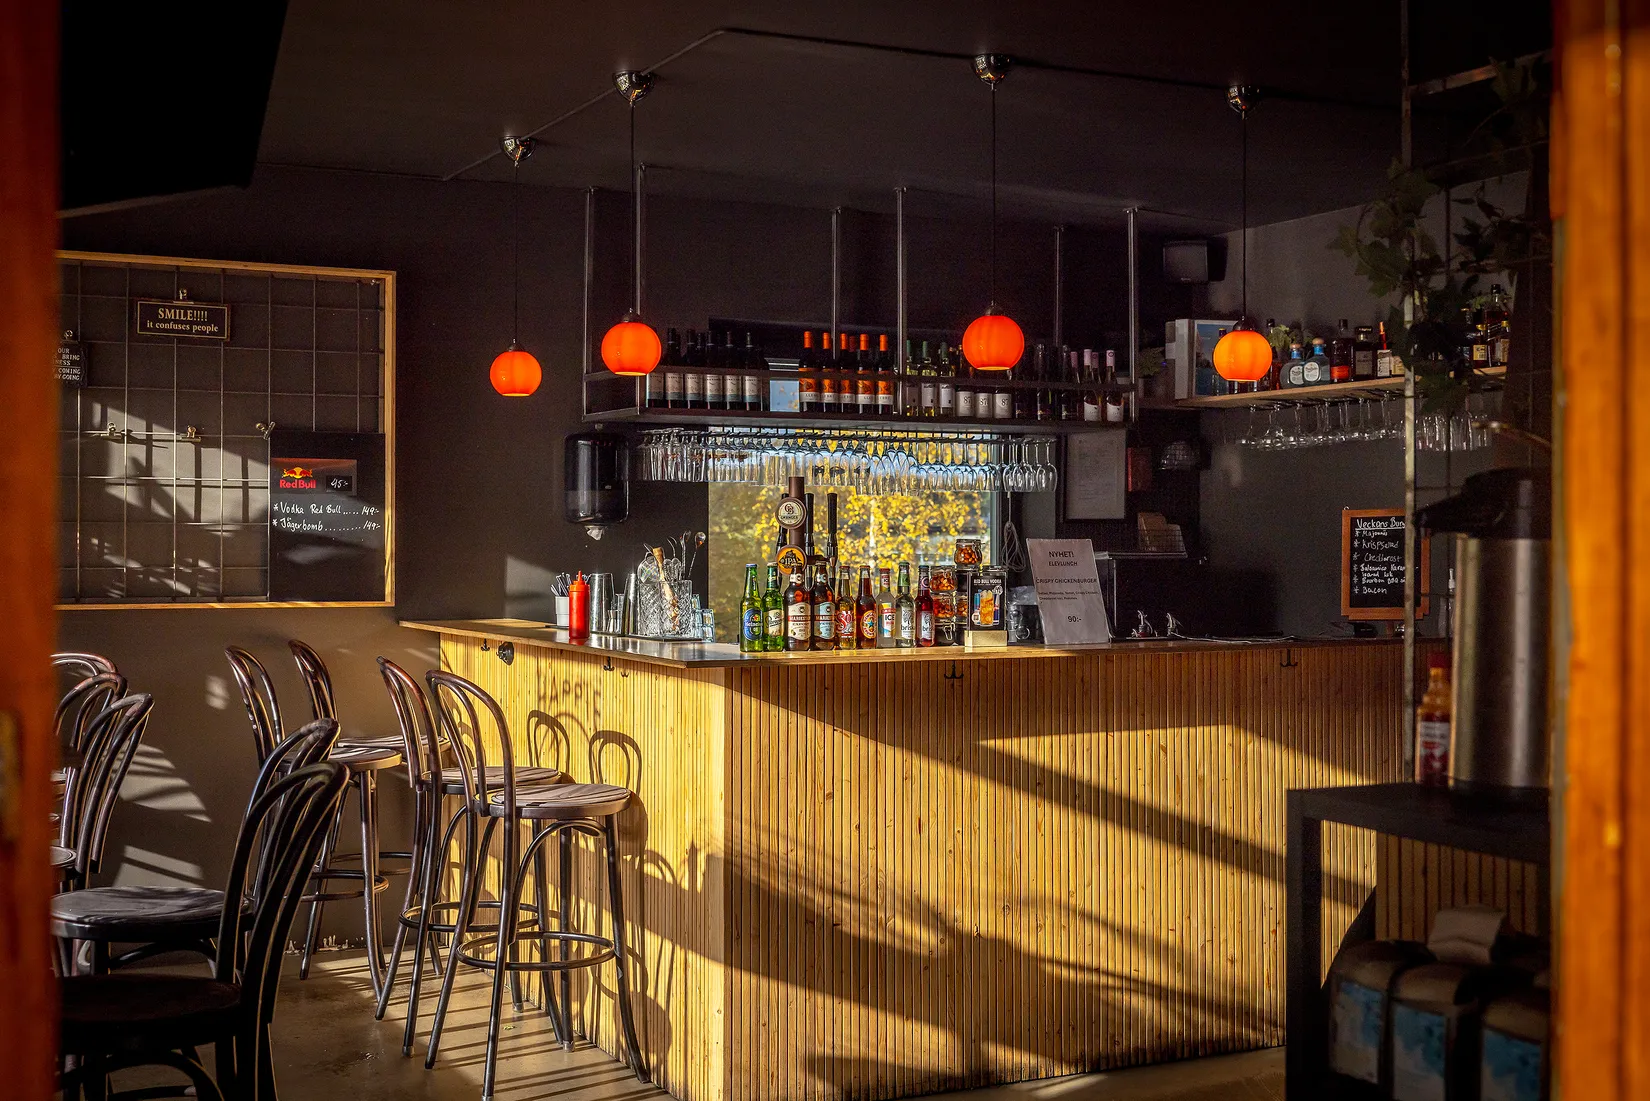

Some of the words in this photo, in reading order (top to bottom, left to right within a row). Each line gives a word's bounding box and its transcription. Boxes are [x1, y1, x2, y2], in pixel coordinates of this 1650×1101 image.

[158, 307, 208, 321] SMILE!!!!
[147, 320, 154, 328] it
[155, 321, 190, 330] confuses
[192, 324, 219, 334] people
[280, 480, 299, 489] Red
[299, 480, 317, 490] Bull
[280, 502, 305, 514] Vodka
[310, 503, 324, 515] Red
[280, 517, 324, 533] Jägerbomb
[1356, 518, 1389, 529] Veckans
[1362, 585, 1388, 595] Bacon
